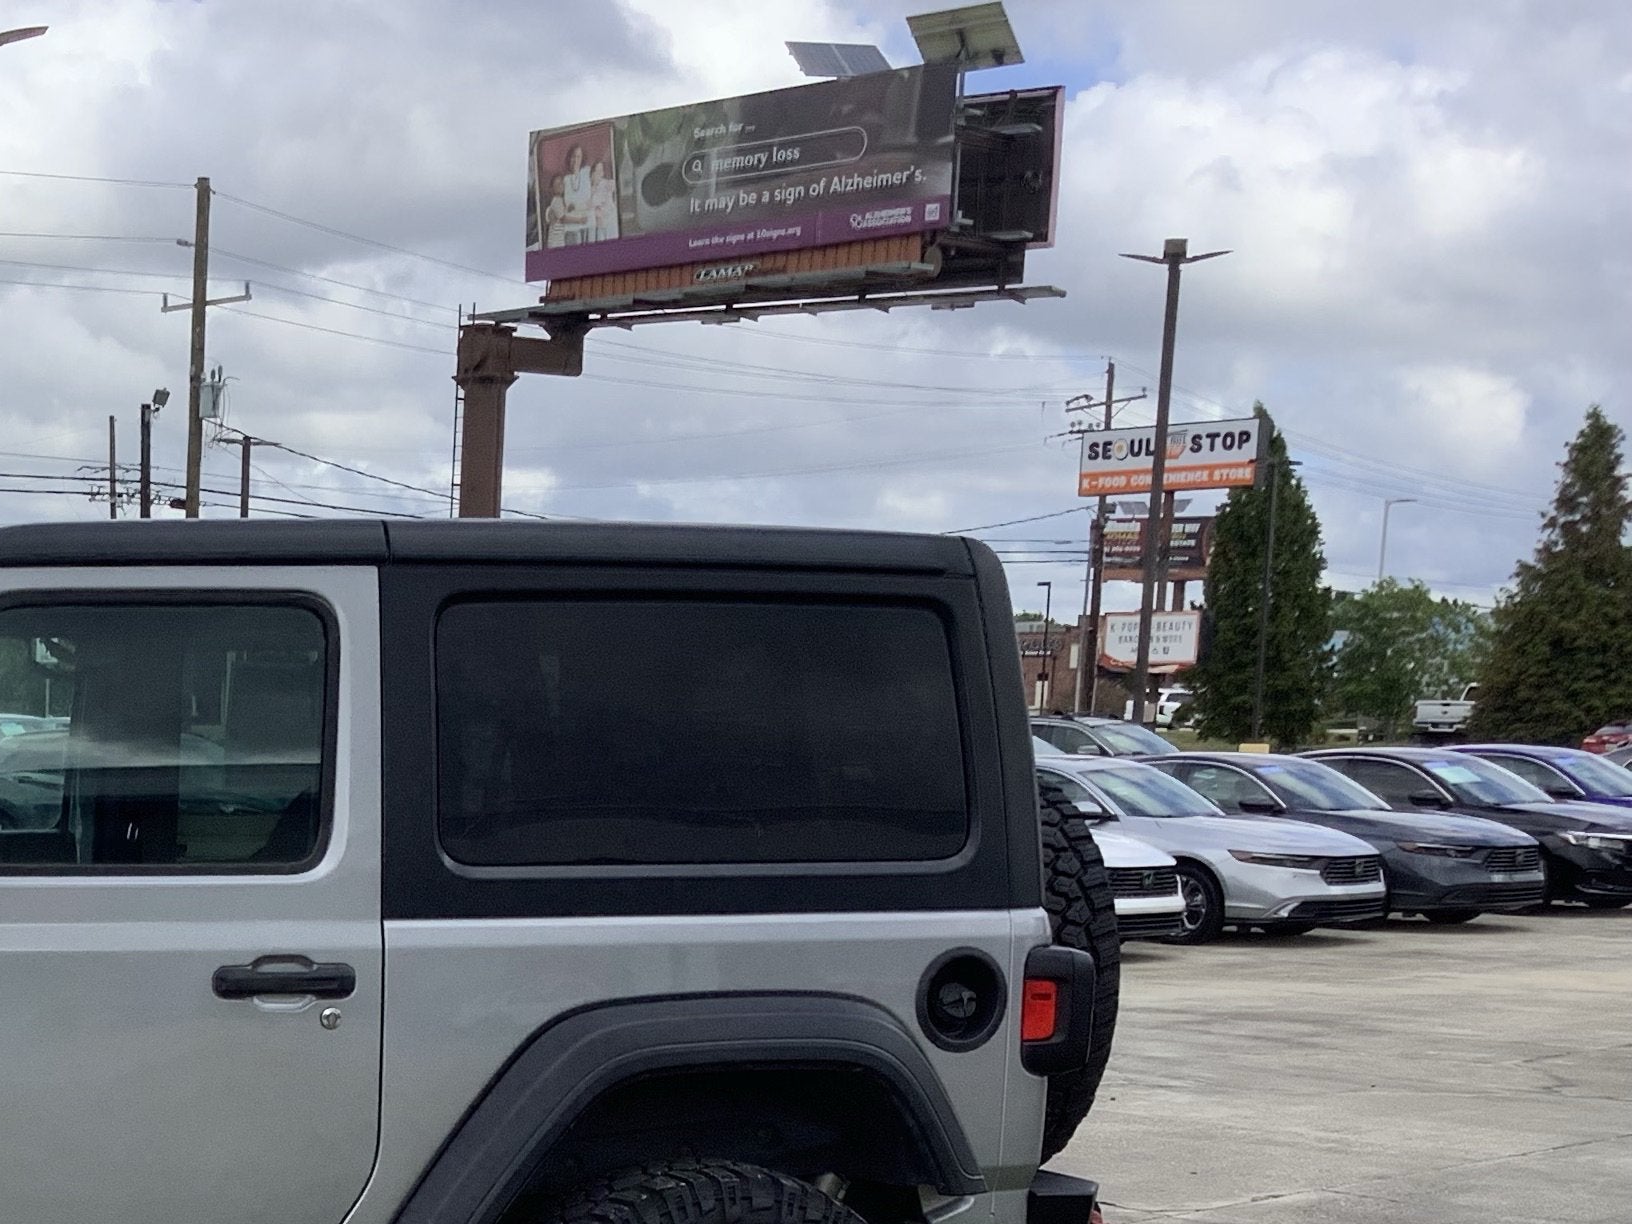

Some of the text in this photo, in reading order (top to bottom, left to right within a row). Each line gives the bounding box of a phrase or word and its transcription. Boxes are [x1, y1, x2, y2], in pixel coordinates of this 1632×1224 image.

[693, 123, 727, 139] Search
[711, 146, 801, 172] memory loss
[690, 166, 927, 214] It may be a sign of Alzheimer's.
[1189, 430, 1251, 453] STOP
